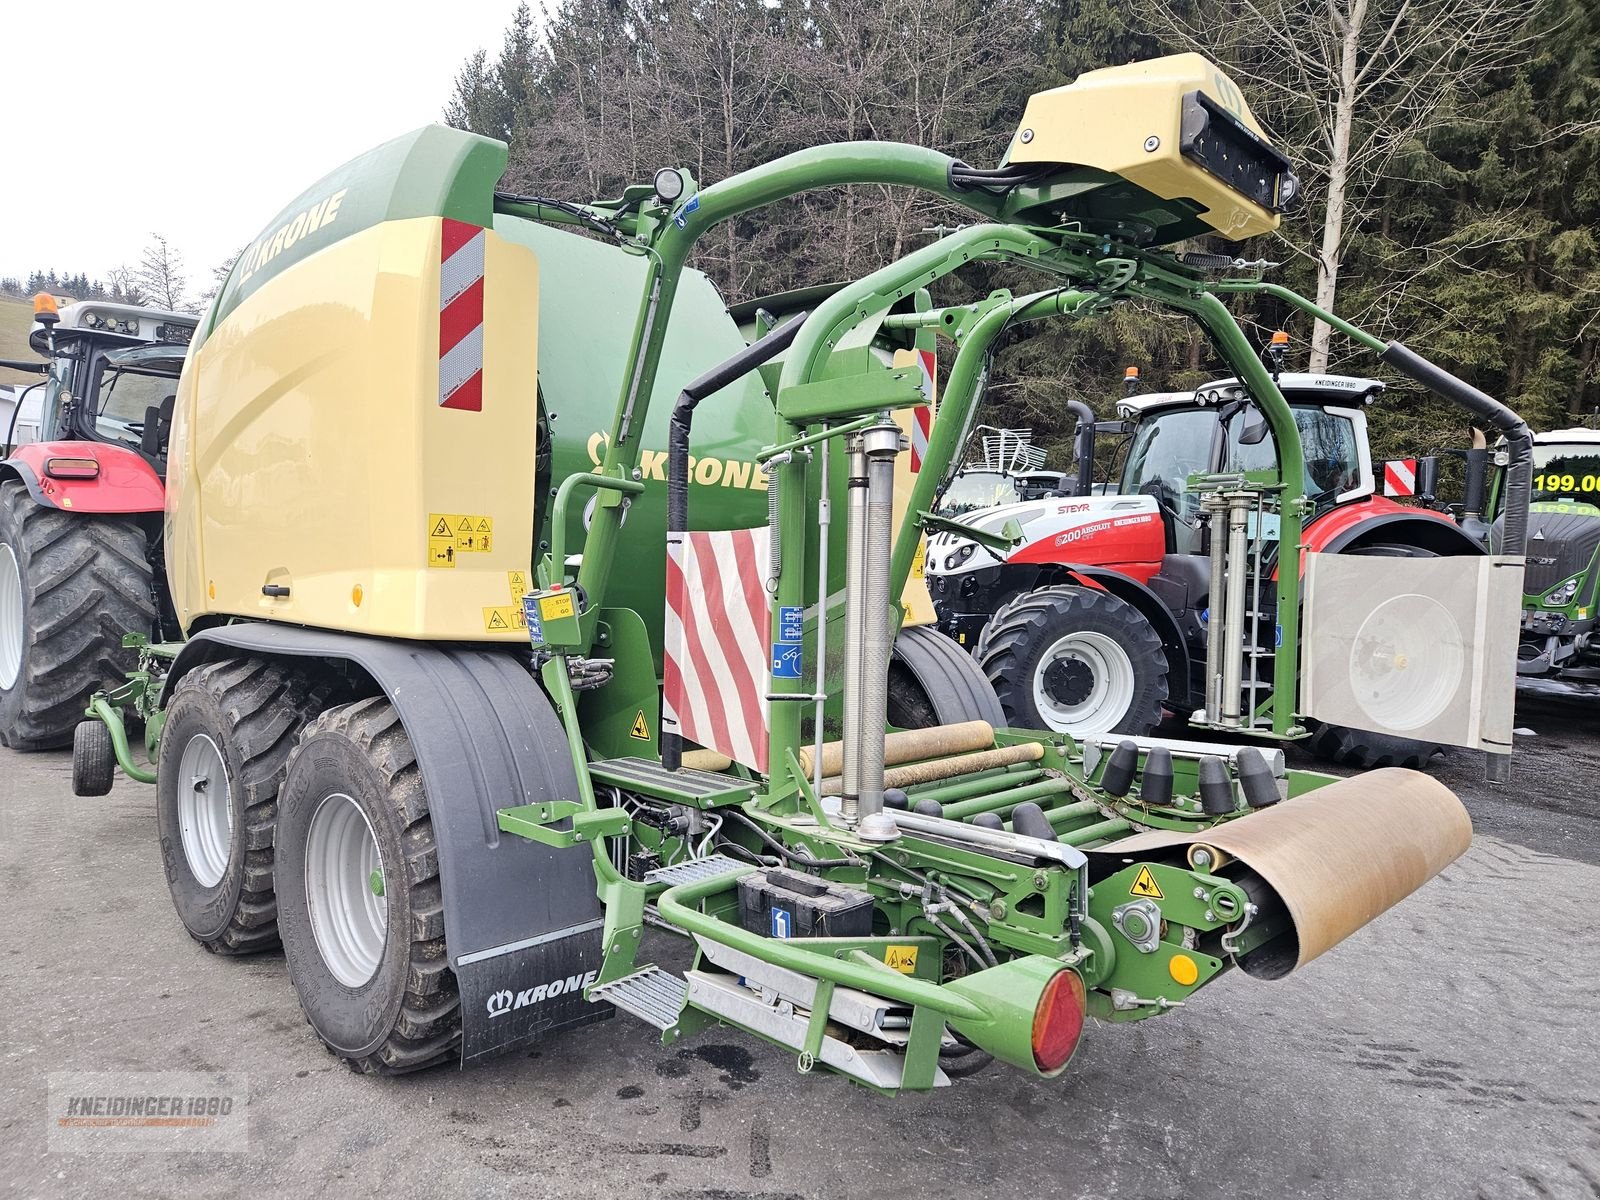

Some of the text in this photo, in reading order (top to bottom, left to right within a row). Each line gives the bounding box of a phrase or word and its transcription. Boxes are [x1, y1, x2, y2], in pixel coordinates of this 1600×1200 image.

[254, 188, 348, 273] KRONE
[640, 449, 770, 491] KONE
[1533, 474, 1600, 492] 199.0
[1057, 503, 1090, 515] STEYR
[1080, 522, 1112, 536] ABSOLUT
[513, 970, 597, 1011] KRONE
